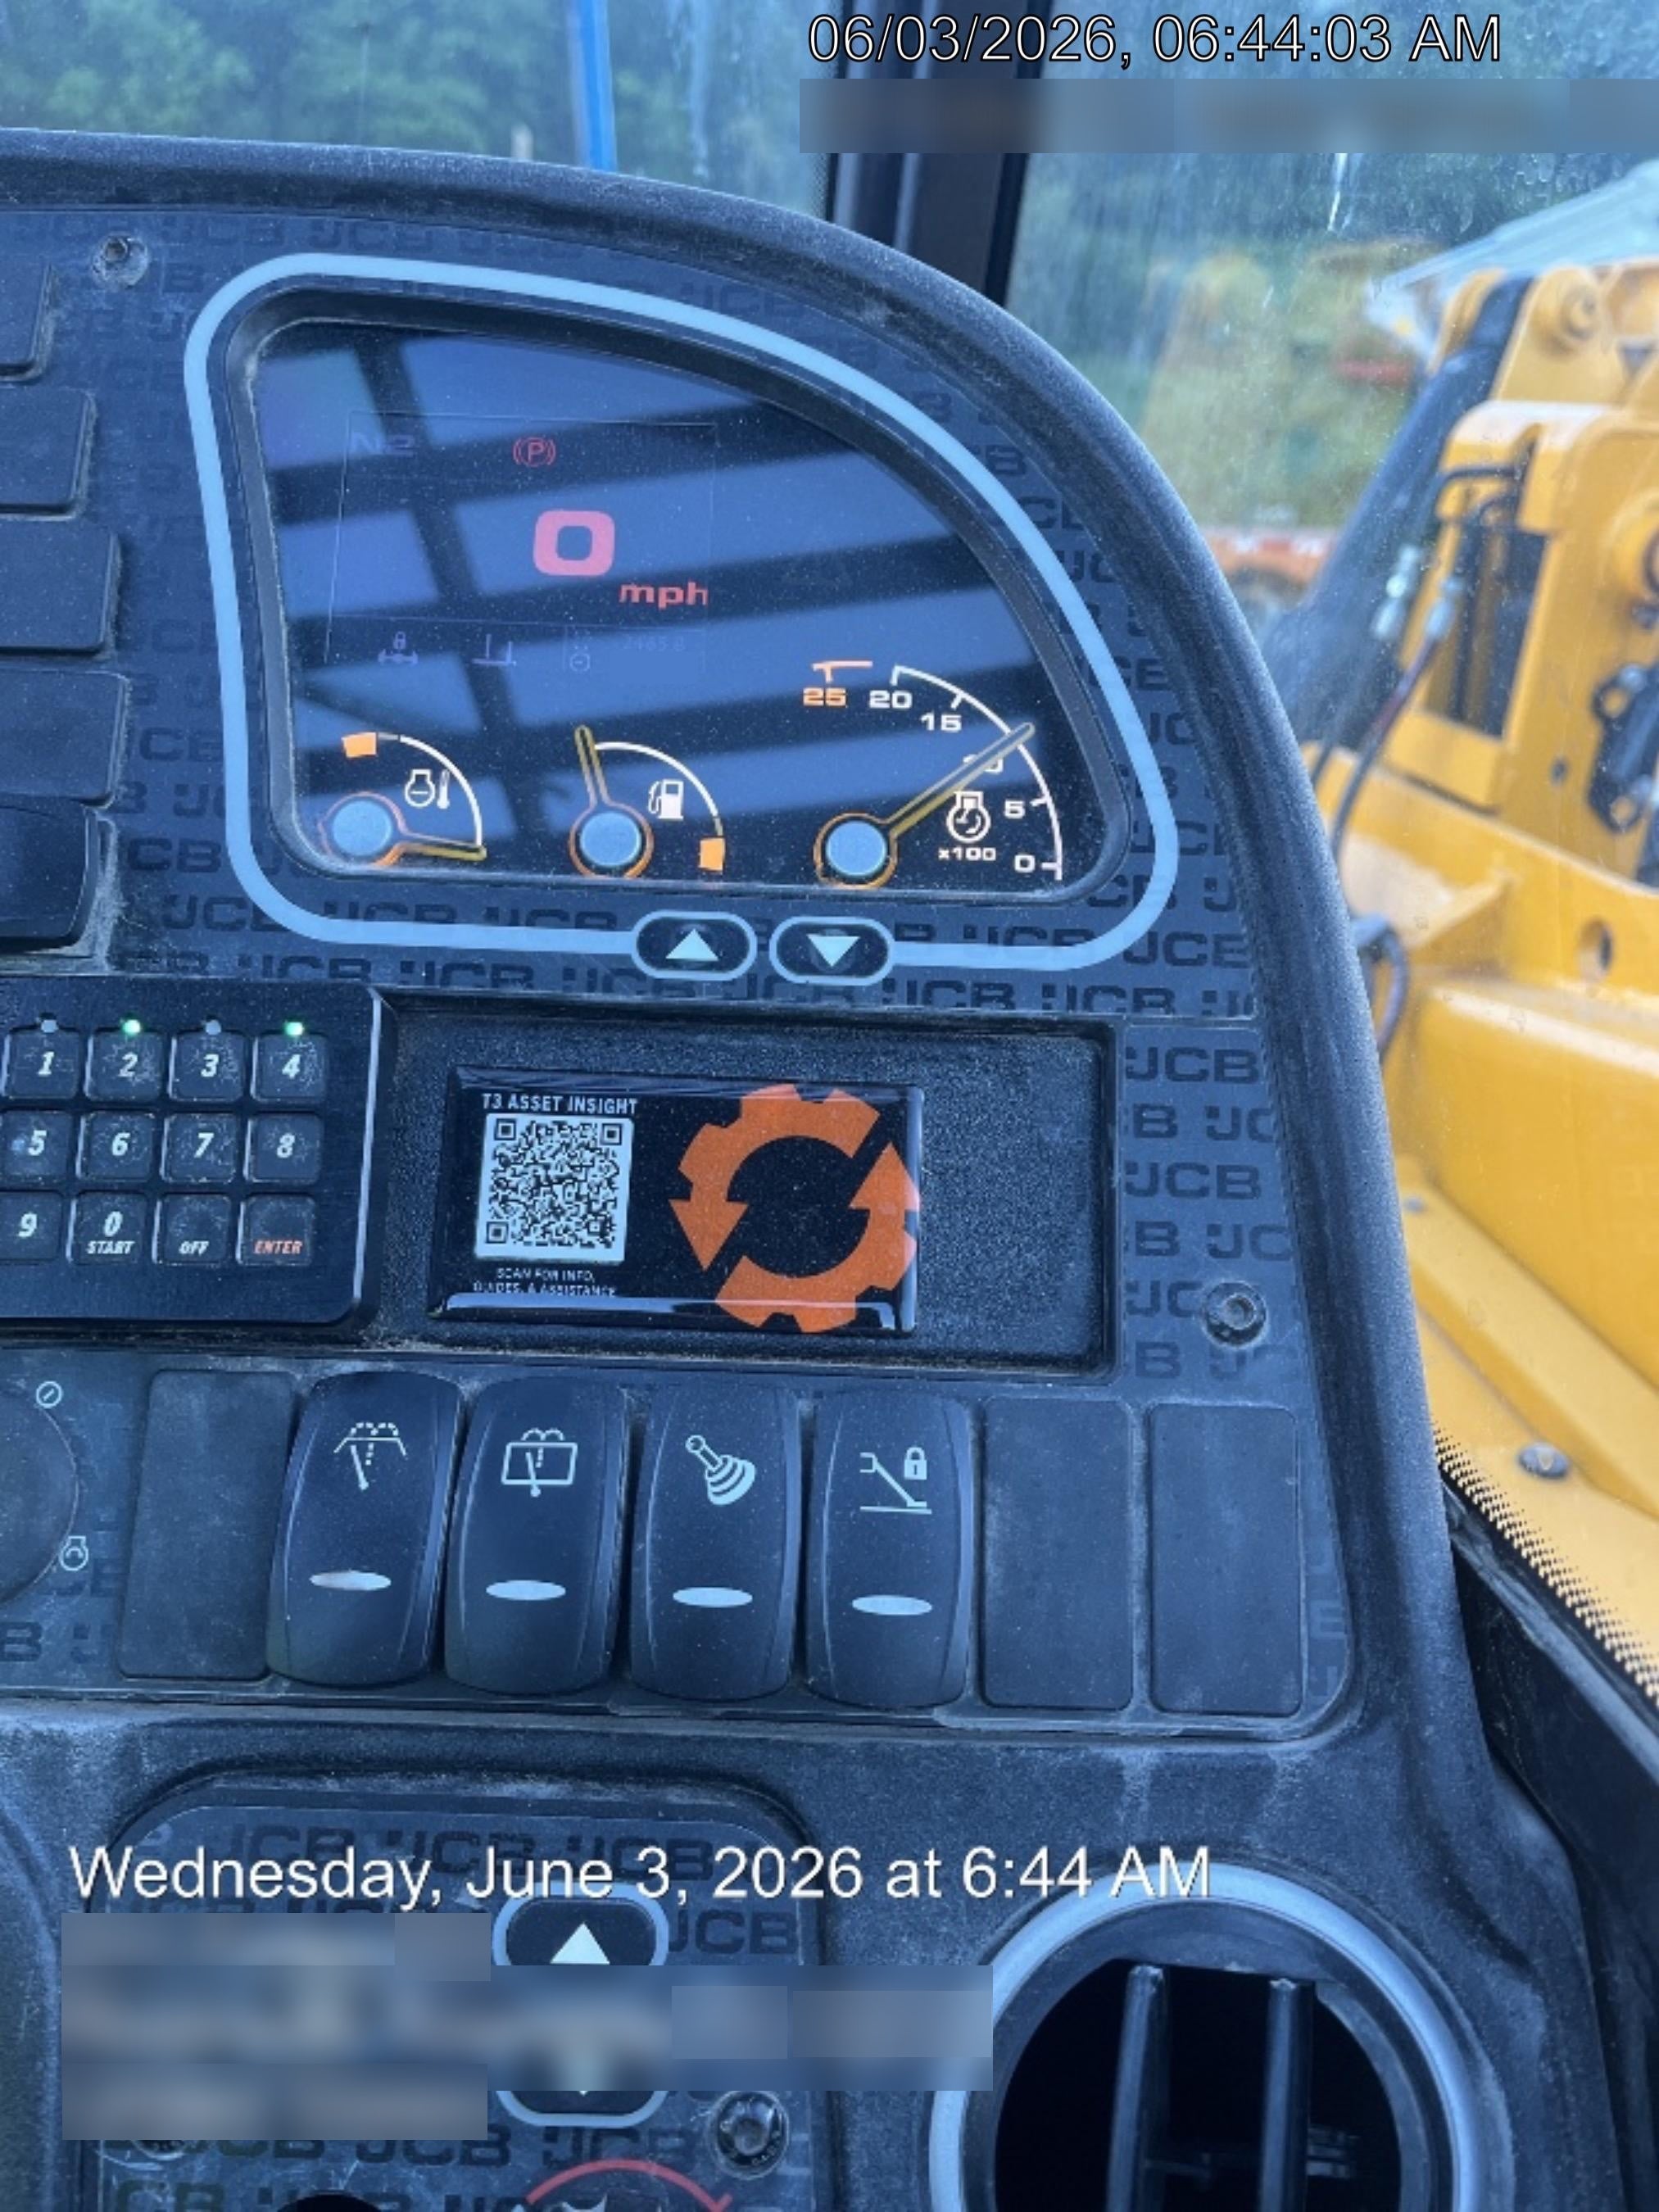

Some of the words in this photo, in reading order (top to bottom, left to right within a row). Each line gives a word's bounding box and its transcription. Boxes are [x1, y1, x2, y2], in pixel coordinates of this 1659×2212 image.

[533, 510, 615, 576] 0
[619, 582, 709, 609] mph
[803, 687, 847, 707] 25
[868, 690, 913, 709] 20
[920, 712, 963, 732] 15
[1004, 800, 1026, 819] 5
[938, 846, 997, 862] x100
[1014, 854, 1036, 873] 0
[37, 1051, 55, 1077] 1
[119, 1052, 139, 1077] 2
[201, 1054, 220, 1078] 3
[282, 1054, 301, 1079] 4
[1125, 1046, 1260, 1085] JCB
[482, 1093, 502, 1110] T3
[508, 1094, 564, 1113] ASSET
[567, 1095, 638, 1115] INSIGHT
[27, 1129, 48, 1156] 5
[111, 1132, 131, 1157] 6
[194, 1132, 215, 1158] 7
[276, 1133, 296, 1158] 8
[1125, 1161, 1261, 1200] JCB
[18, 1213, 38, 1238] 9
[103, 1211, 123, 1236] 0
[86, 1240, 136, 1255] START
[178, 1240, 210, 1255] OFF
[253, 1240, 304, 1255] ENTER
